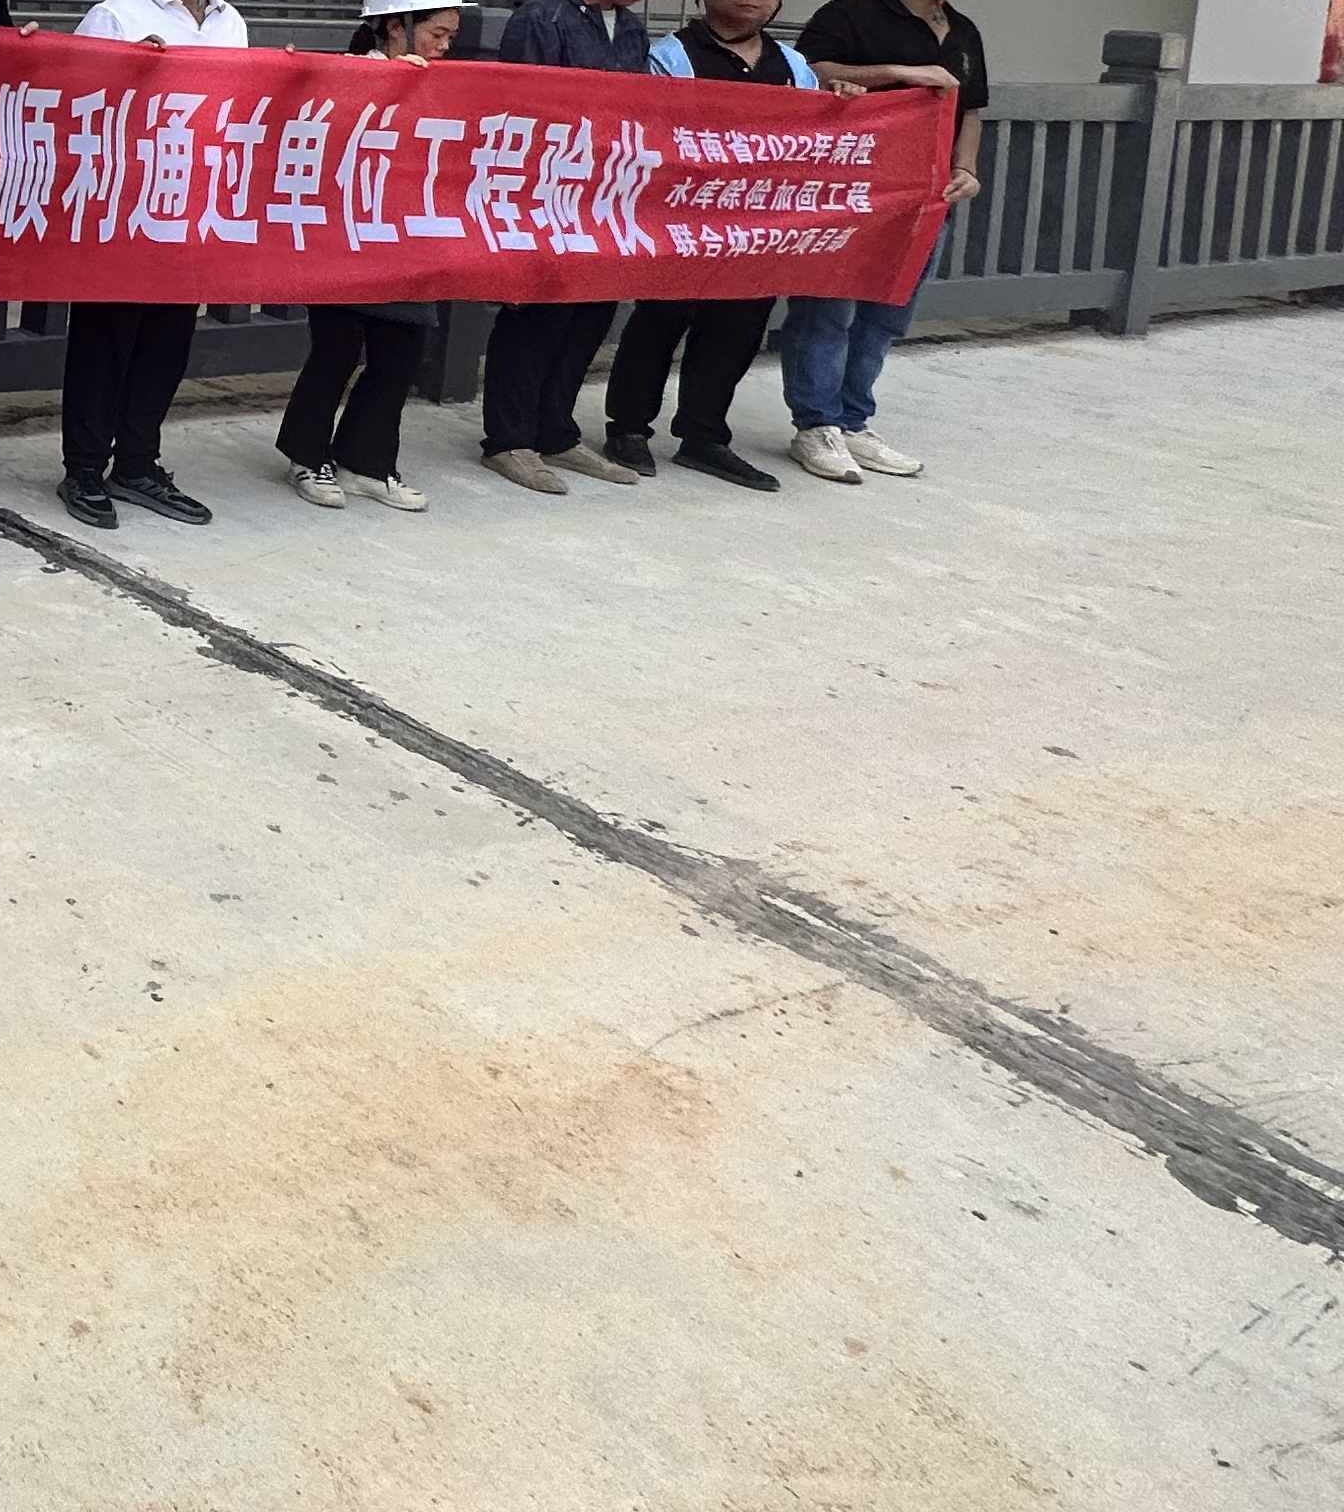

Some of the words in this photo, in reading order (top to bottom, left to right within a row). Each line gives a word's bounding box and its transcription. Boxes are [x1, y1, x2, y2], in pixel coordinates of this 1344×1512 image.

[672, 127, 876, 165] 海南省2022年病险
[664, 176, 874, 214] 水库除险加固工程
[665, 223, 858, 258] 联合体EPC项目部
